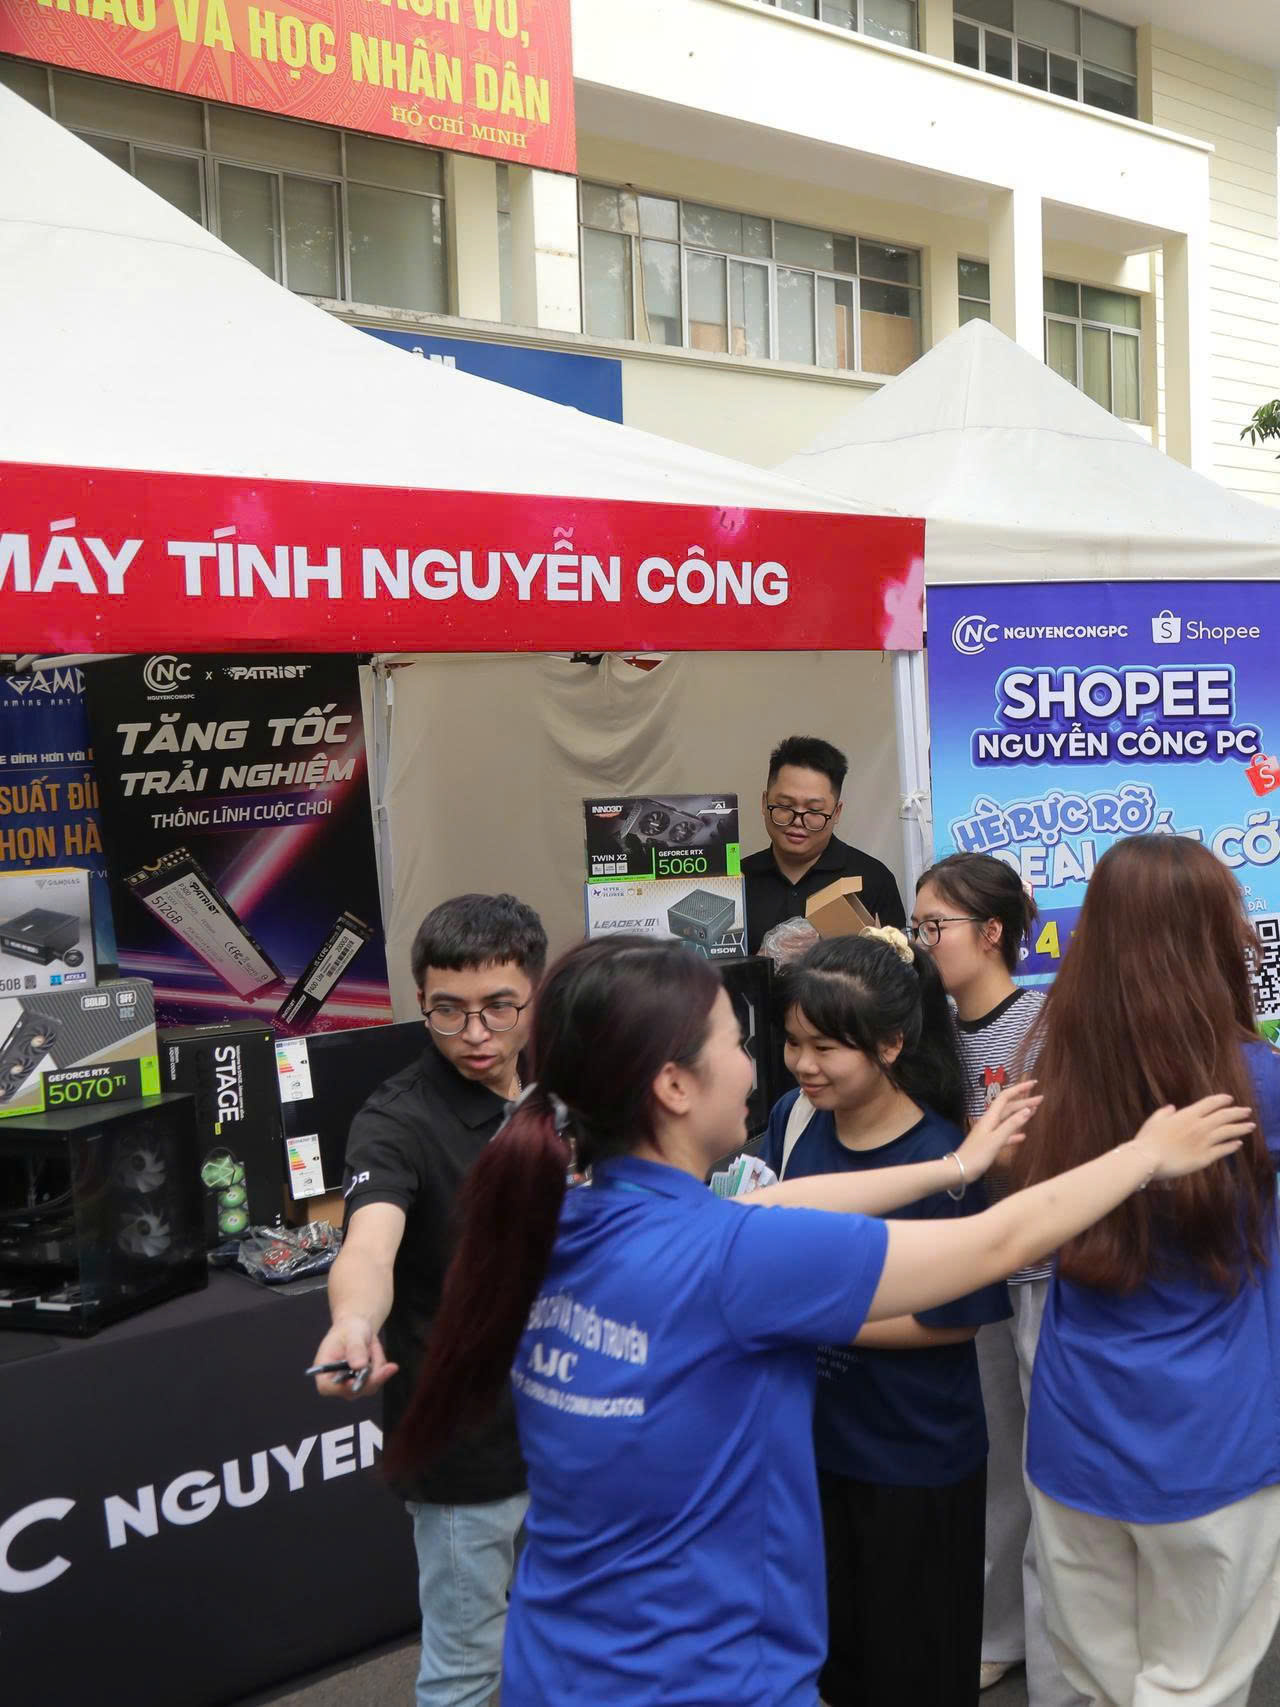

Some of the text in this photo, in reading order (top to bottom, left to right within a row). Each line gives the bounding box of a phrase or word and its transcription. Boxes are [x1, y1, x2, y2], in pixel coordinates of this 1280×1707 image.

[248, 6, 336, 80] HỌC
[350, 32, 463, 105] NHÂN
[475, 60, 550, 125] DÂN
[391, 103, 527, 148] HỒ CHÍ MINH
[167, 525, 343, 599] TÍNH
[362, 526, 621, 602] NGUYỄN
[636, 544, 788, 606] CÔNG
[1003, 624, 1129, 640] NGUYENCONGPC
[1186, 621, 1261, 645] Shopee
[1002, 670, 1230, 720] SHOPEE
[116, 703, 353, 756] TĂNG TỐC
[978, 722, 1257, 759] NGUYỄN CÔNG PC
[120, 752, 356, 797] TRẢI NGHIỆM
[0, 775, 60, 815] SUẤT
[592, 806, 623, 814] INNO3D
[151, 798, 332, 829] THỐNG LĨNH CUỘC CHƠI
[956, 799, 1005, 851] HÈ
[1006, 793, 1088, 843] RỰC
[591, 855, 615, 863] TWIN
[658, 849, 689, 857] GEFORCE
[659, 857, 708, 875] 5060
[151, 895, 183, 925] 512GB
[593, 919, 642, 930] LEADEX
[710, 946, 737, 954] 850W
[1035, 920, 1061, 959] 4
[48, 1067, 111, 1083] GEFORCE RTX
[48, 1075, 126, 1105] 5070 Ti
[214, 1045, 240, 1123] STAGE
